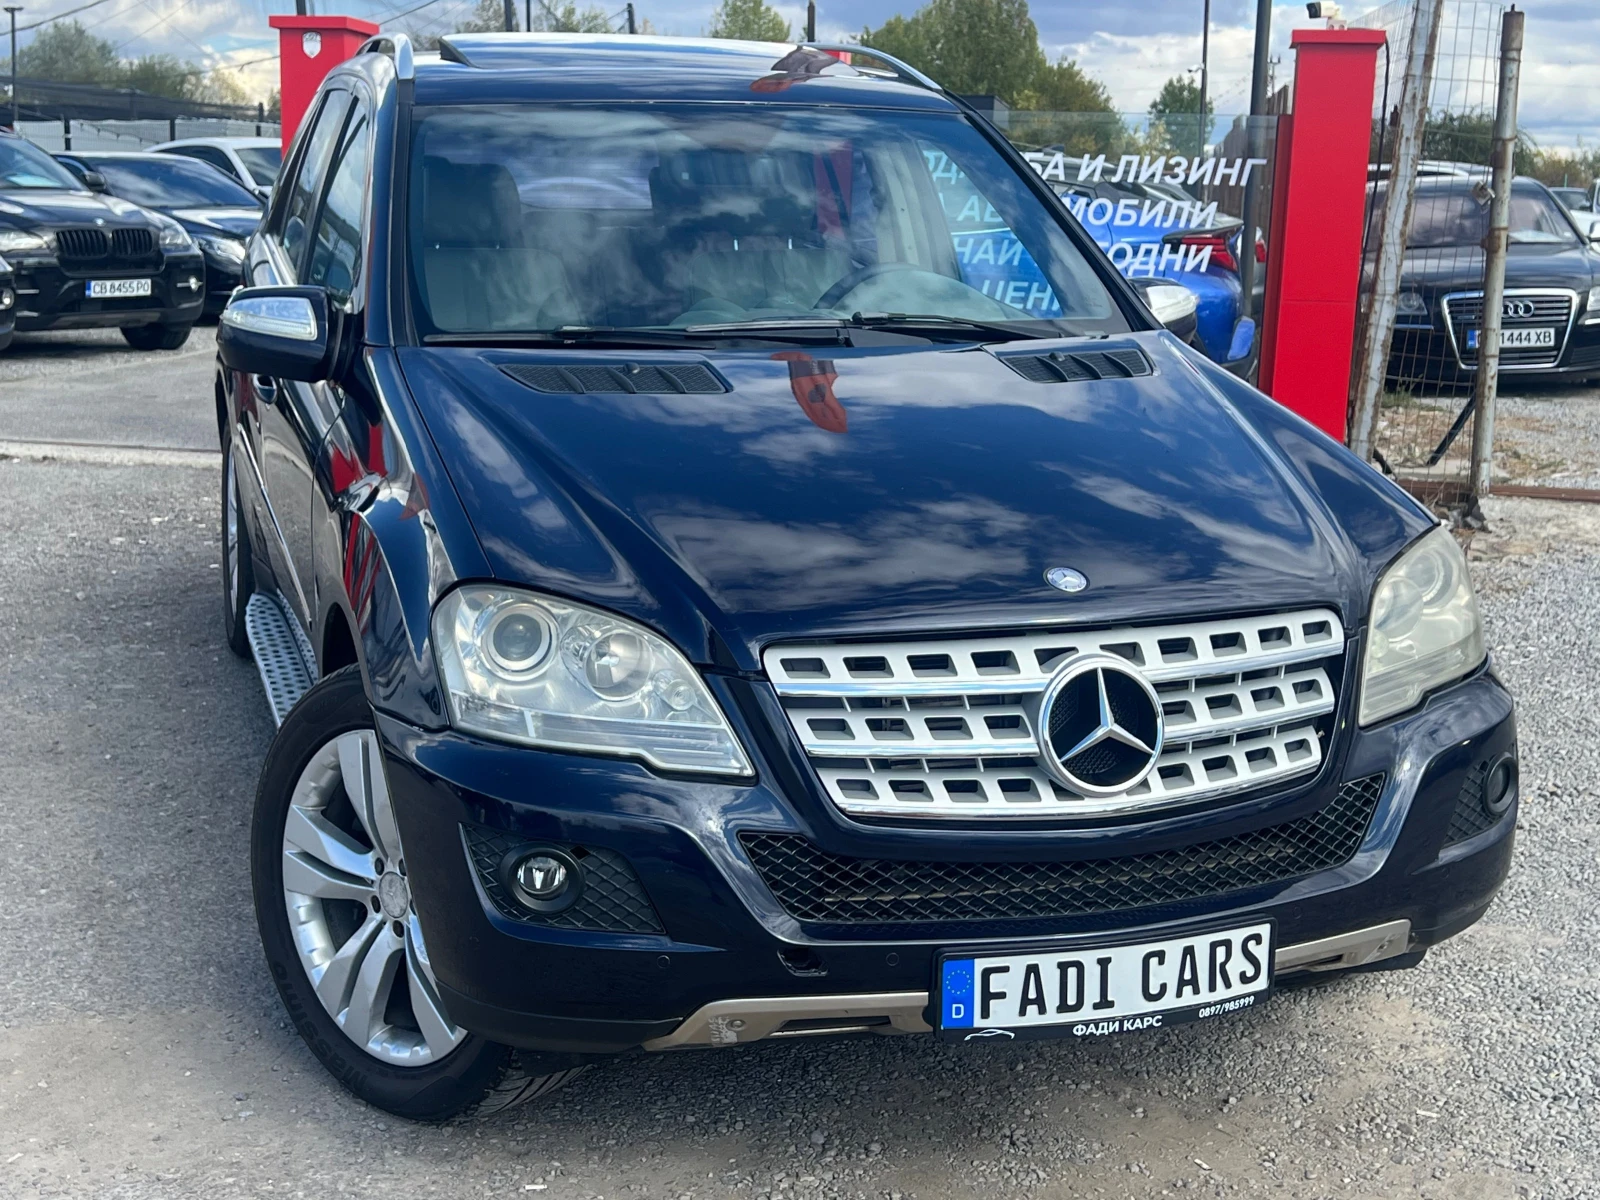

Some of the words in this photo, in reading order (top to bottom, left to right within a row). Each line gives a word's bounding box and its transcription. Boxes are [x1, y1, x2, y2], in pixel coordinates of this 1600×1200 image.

[1077, 153, 1106, 182] И
[1111, 154, 1267, 187] ЛИЗИНГ
[93, 281, 107, 295] CB
[109, 280, 135, 294] 8455
[1500, 331, 1531, 345] 1444
[1535, 331, 1552, 344] XB
[980, 956, 1115, 1020] FADI
[1141, 933, 1263, 1003] CARS
[951, 1003, 965, 1019] D
[1198, 996, 1255, 1019] 0897/985999
[1072, 1021, 1119, 1037] ФАДИ
[1123, 1015, 1163, 1032] КАРС
